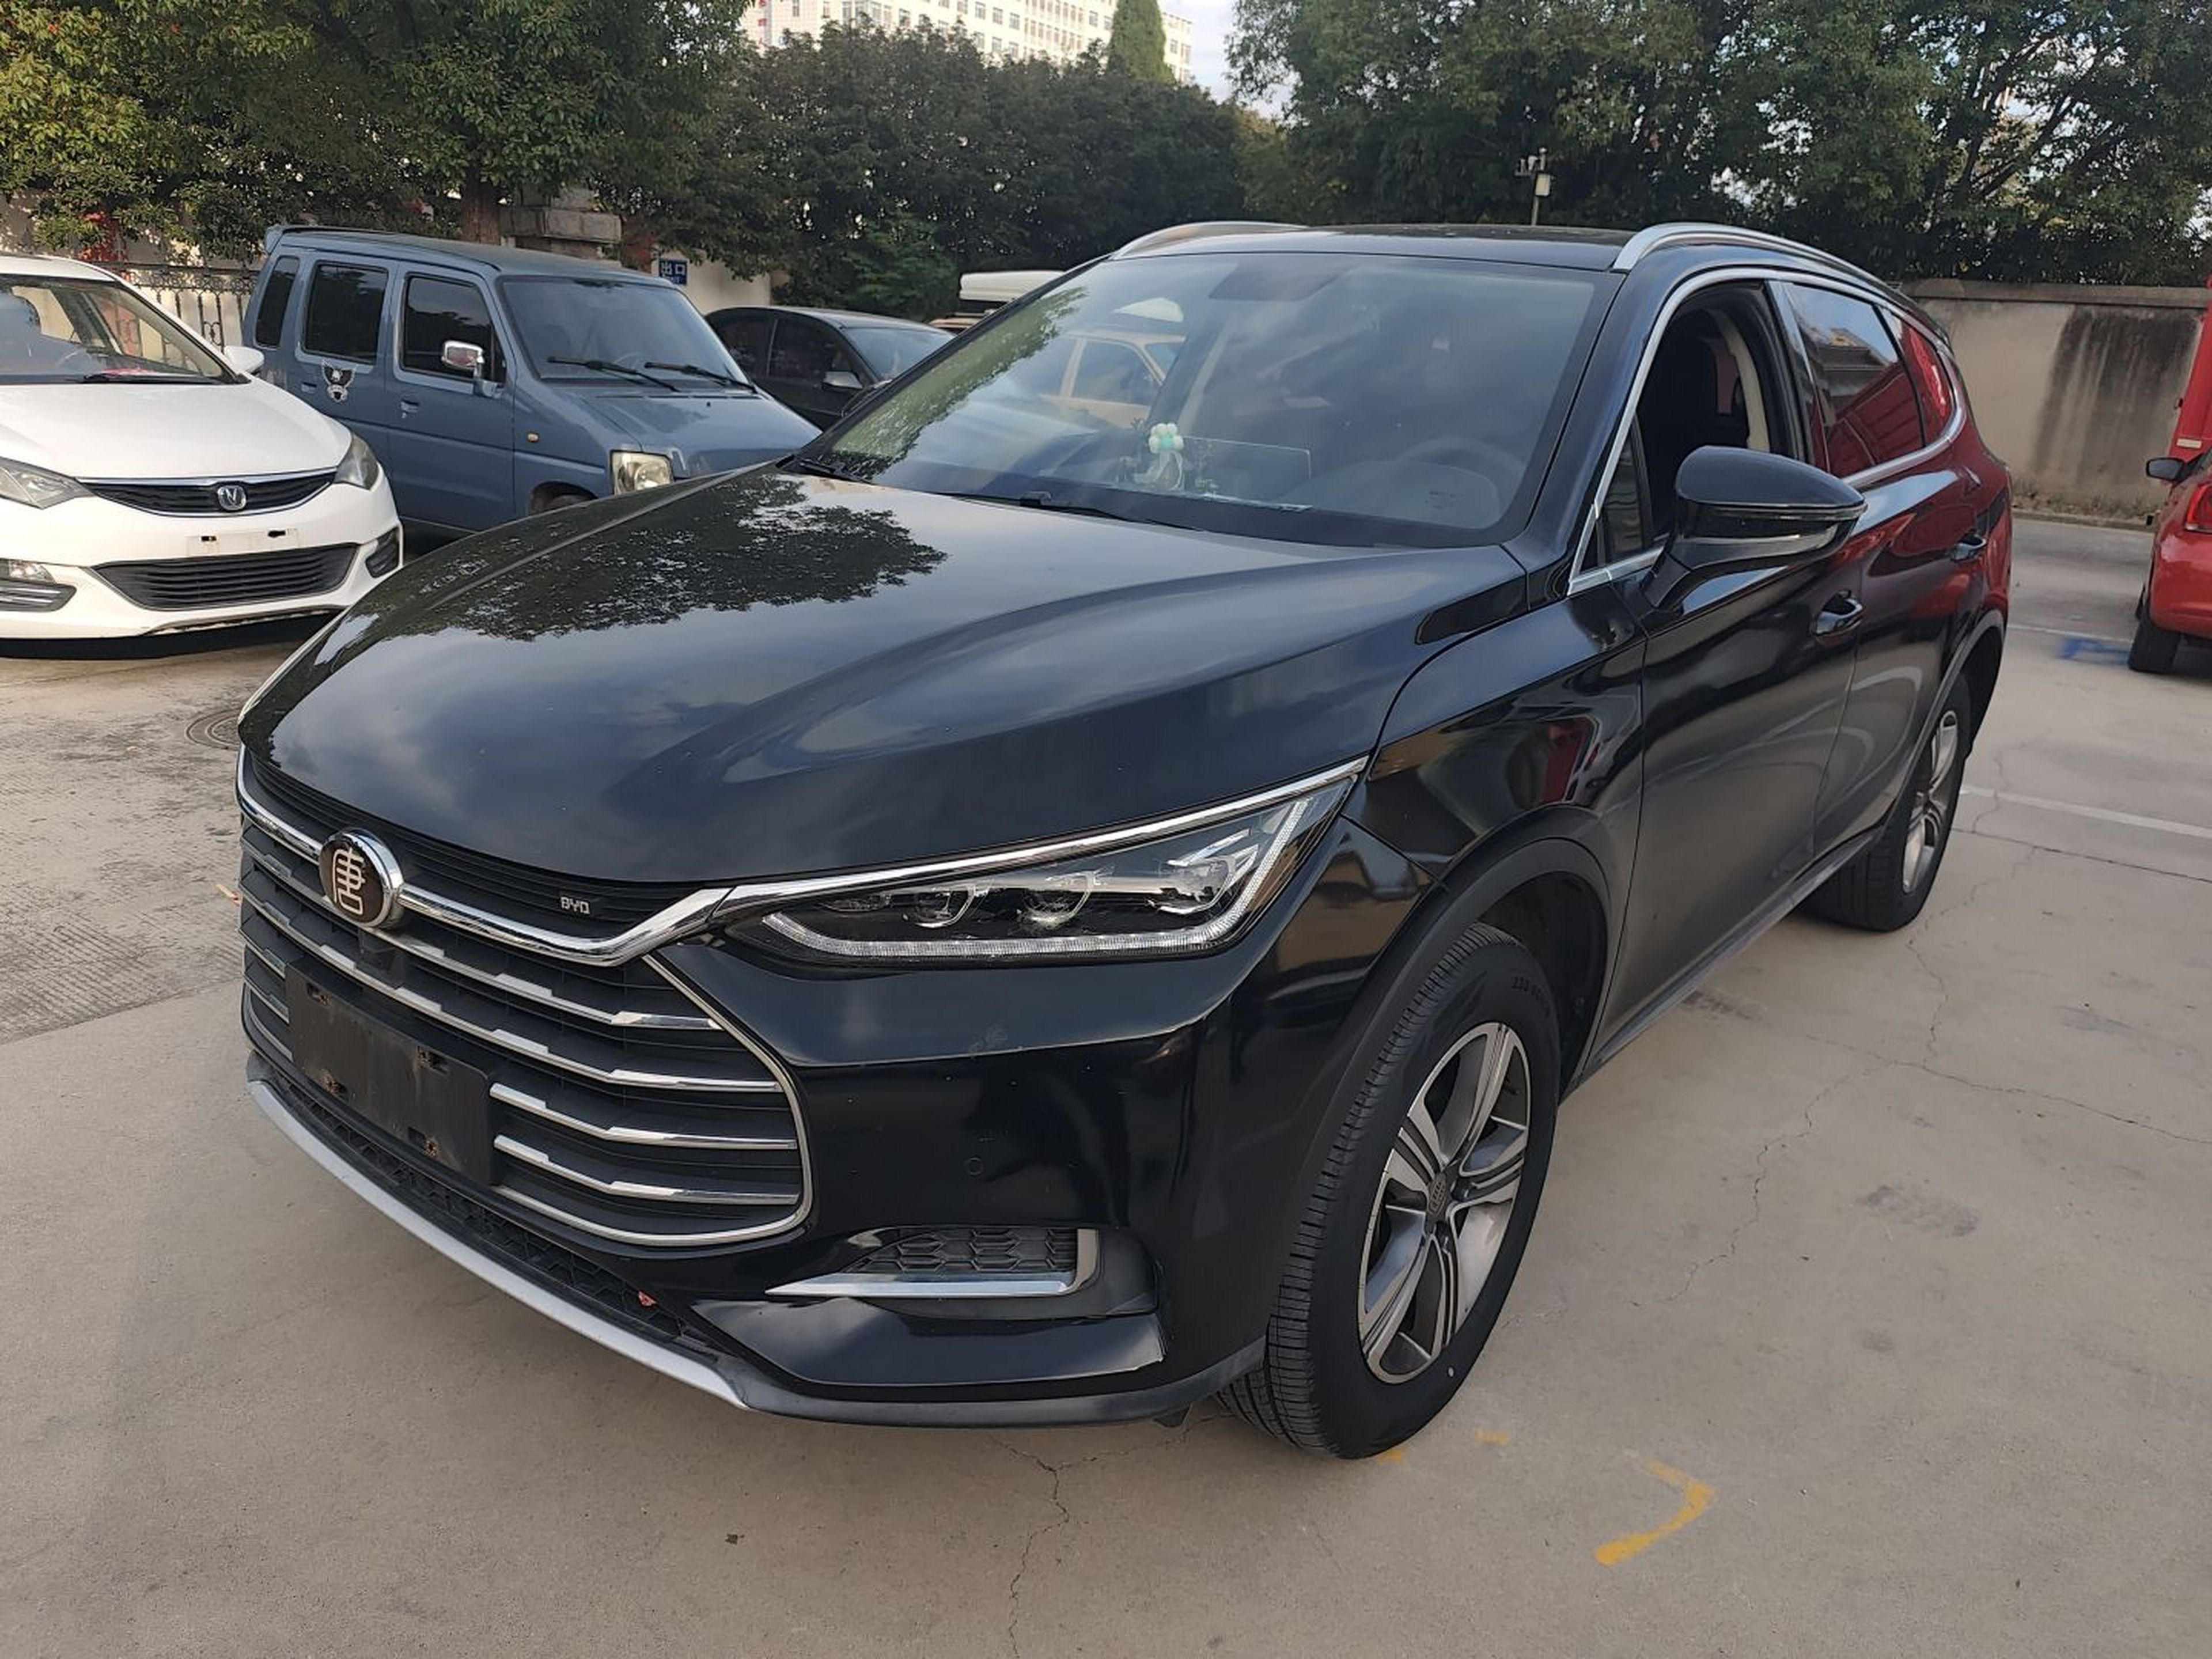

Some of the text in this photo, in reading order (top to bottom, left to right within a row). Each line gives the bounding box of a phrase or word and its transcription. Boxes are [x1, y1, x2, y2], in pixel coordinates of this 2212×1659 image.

[661, 262, 685, 276] 出口
[332, 847, 366, 915] 唐
[560, 896, 590, 914] BYD
